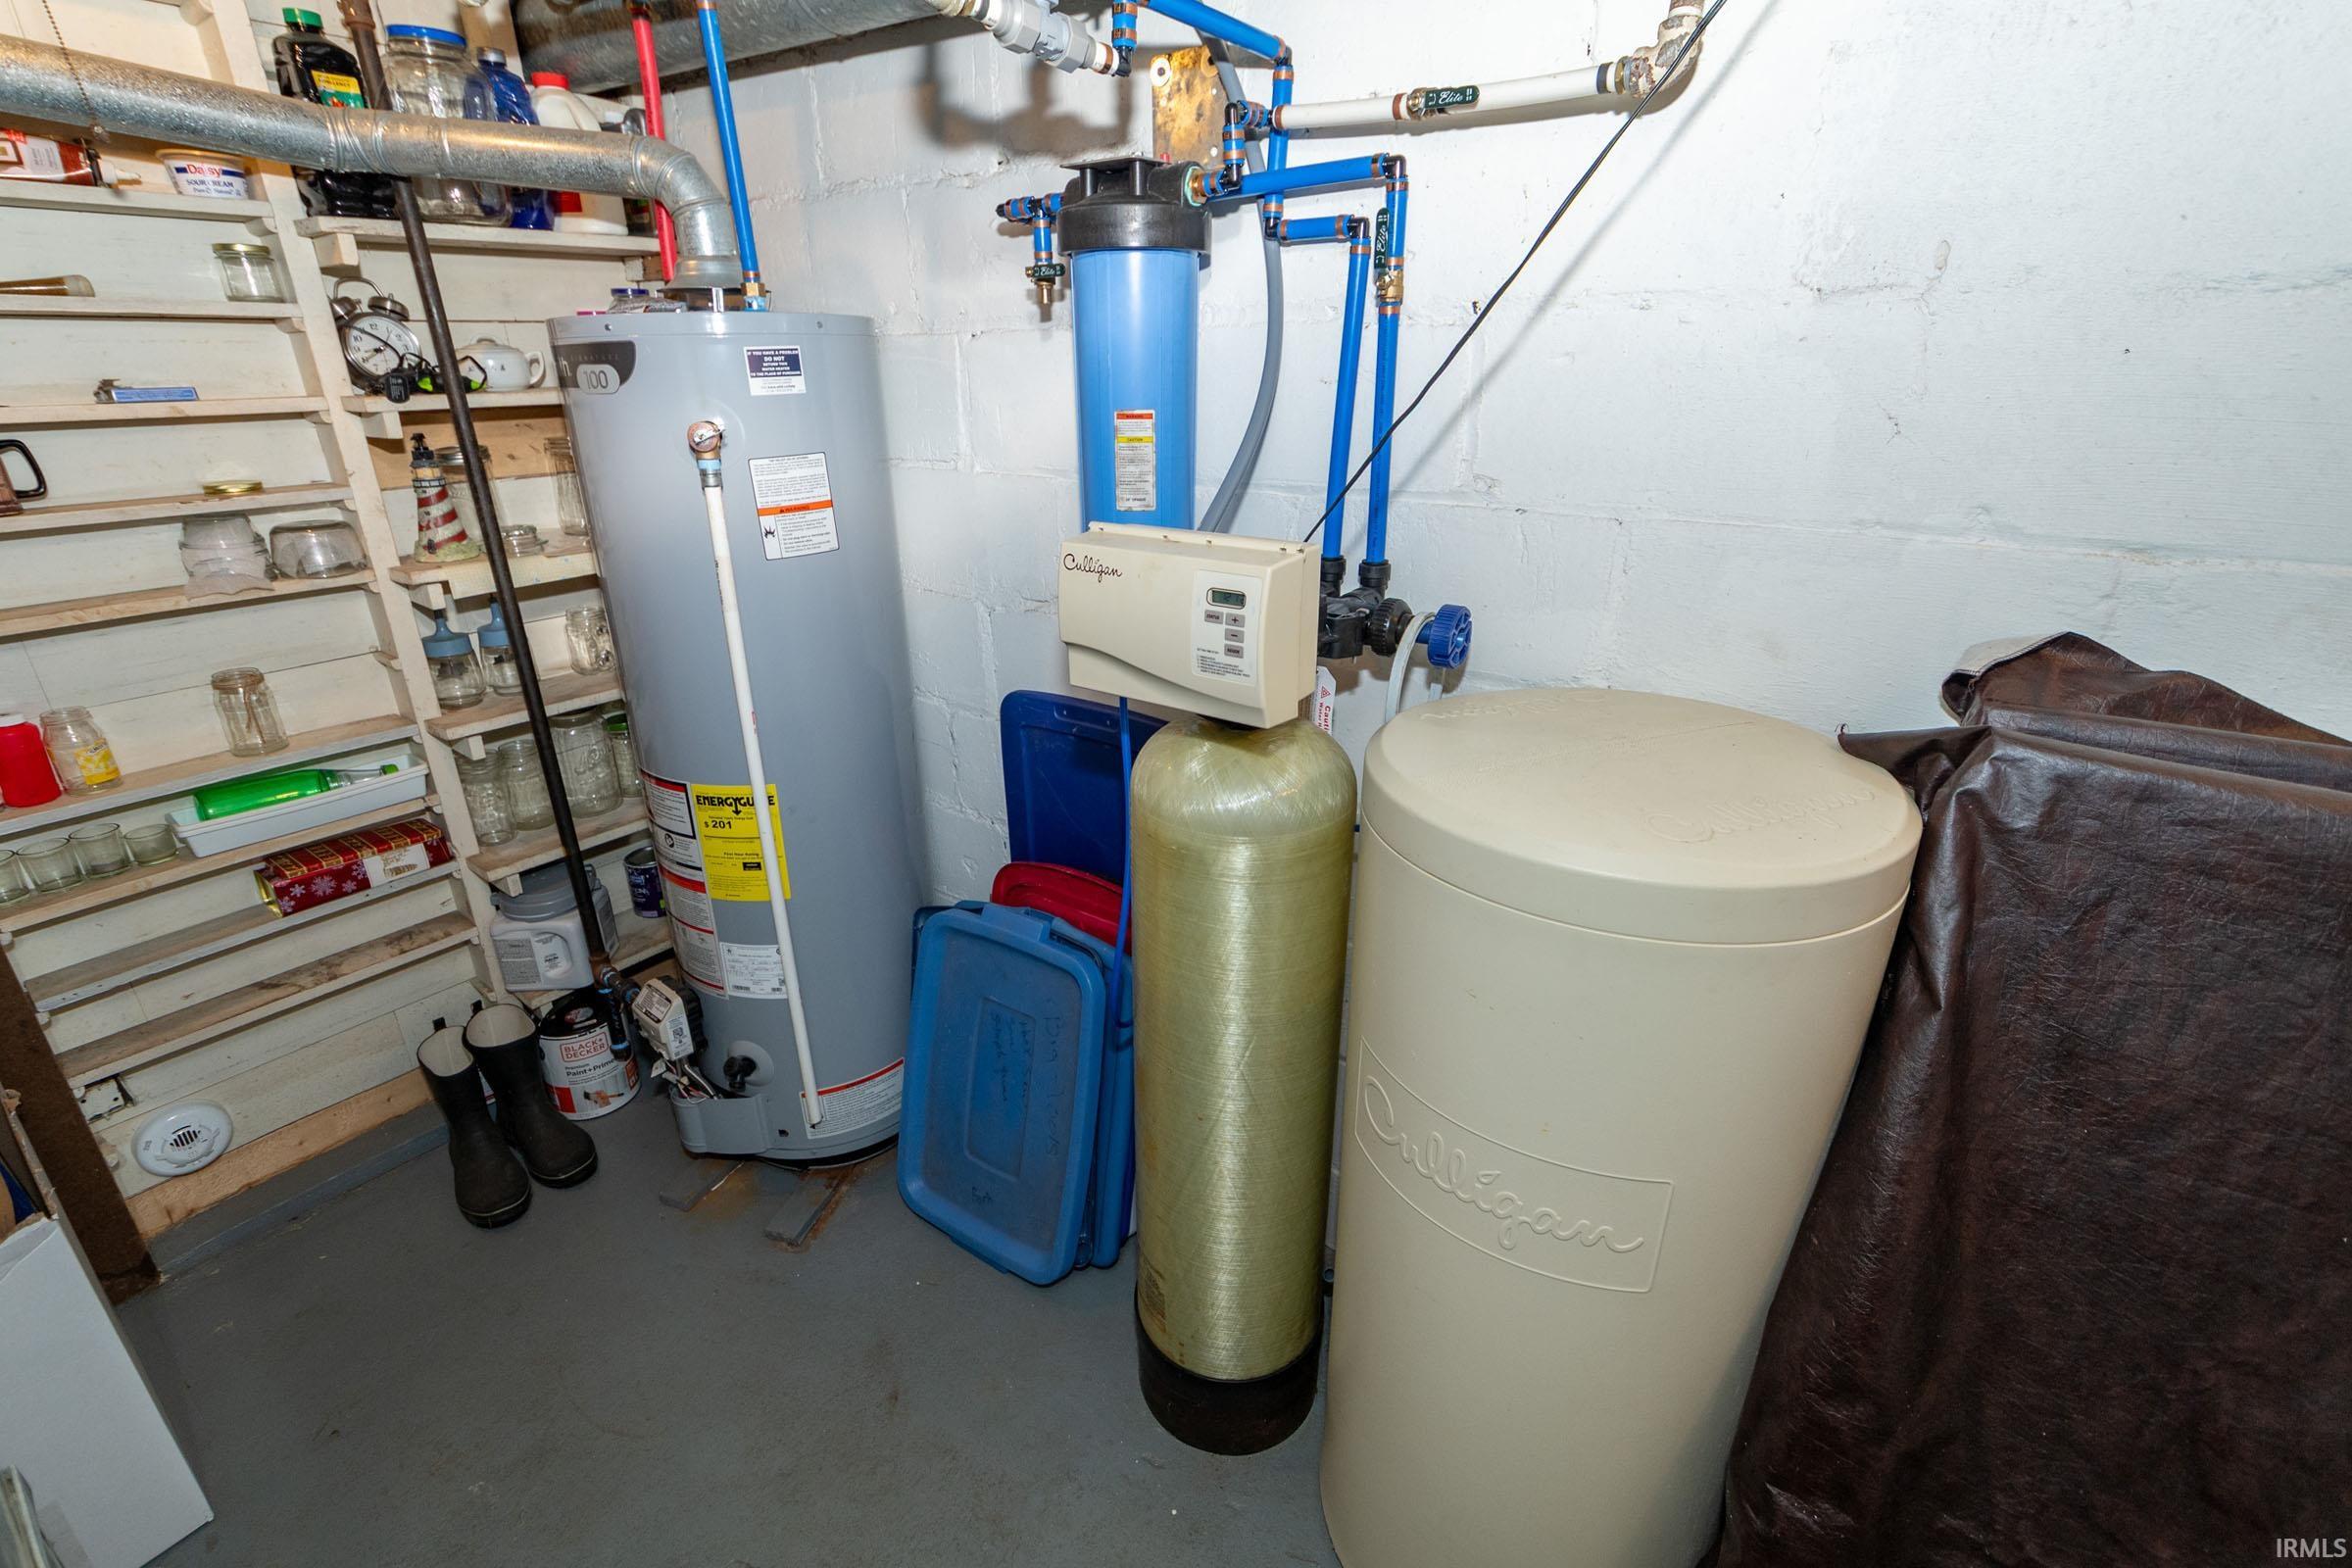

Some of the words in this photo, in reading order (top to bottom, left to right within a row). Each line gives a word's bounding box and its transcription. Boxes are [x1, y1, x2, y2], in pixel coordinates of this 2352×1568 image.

[1439, 90, 1464, 105] Elite
[186, 178, 206, 187] SOUR
[1377, 224, 1387, 252] Elite
[1040, 266, 1055, 276] Elite
[582, 369, 609, 389] 100
[1062, 553, 1123, 583] Culligan
[696, 795, 775, 811] ENERGYGUE
[1643, 786, 1877, 845] Culligan
[711, 820, 732, 830] 201
[564, 1043, 606, 1059] DECKER
[565, 1058, 614, 1077] Paint+Prime
[1364, 1075, 1644, 1251] Culligan
